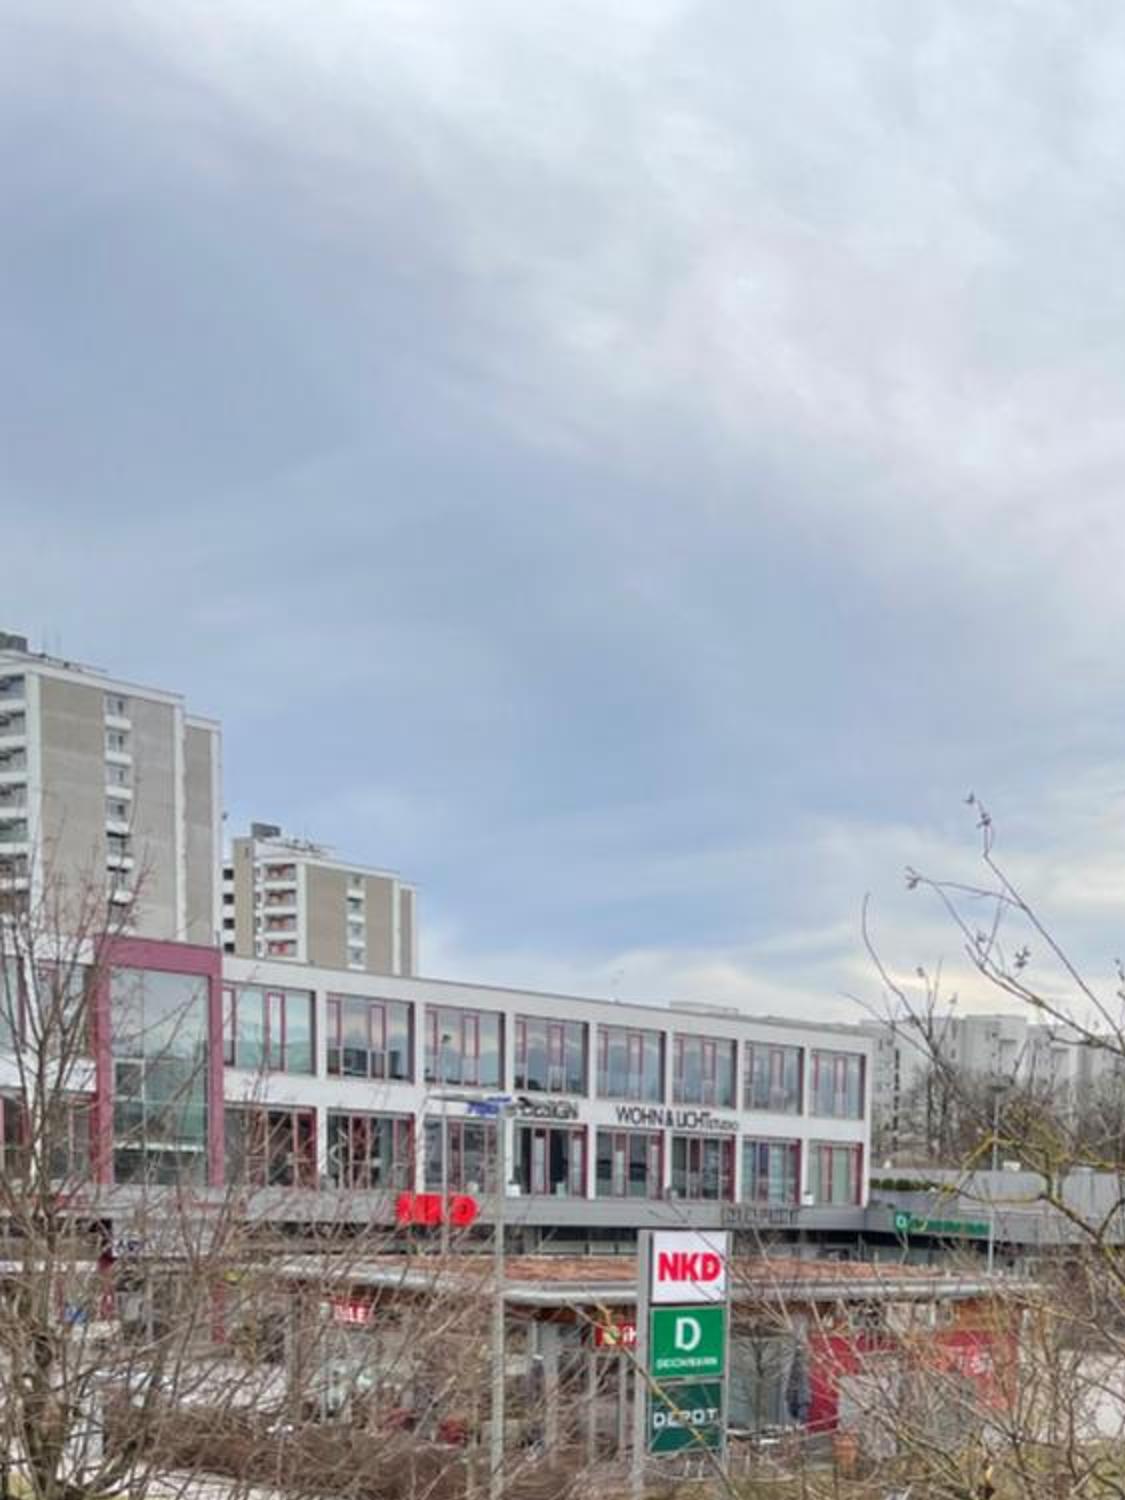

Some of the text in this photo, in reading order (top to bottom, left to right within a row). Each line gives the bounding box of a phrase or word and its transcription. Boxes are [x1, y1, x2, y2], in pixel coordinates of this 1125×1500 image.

[615, 1105, 663, 1126] WOHN
[657, 1252, 721, 1282] NKD
[674, 1316, 702, 1351] D
